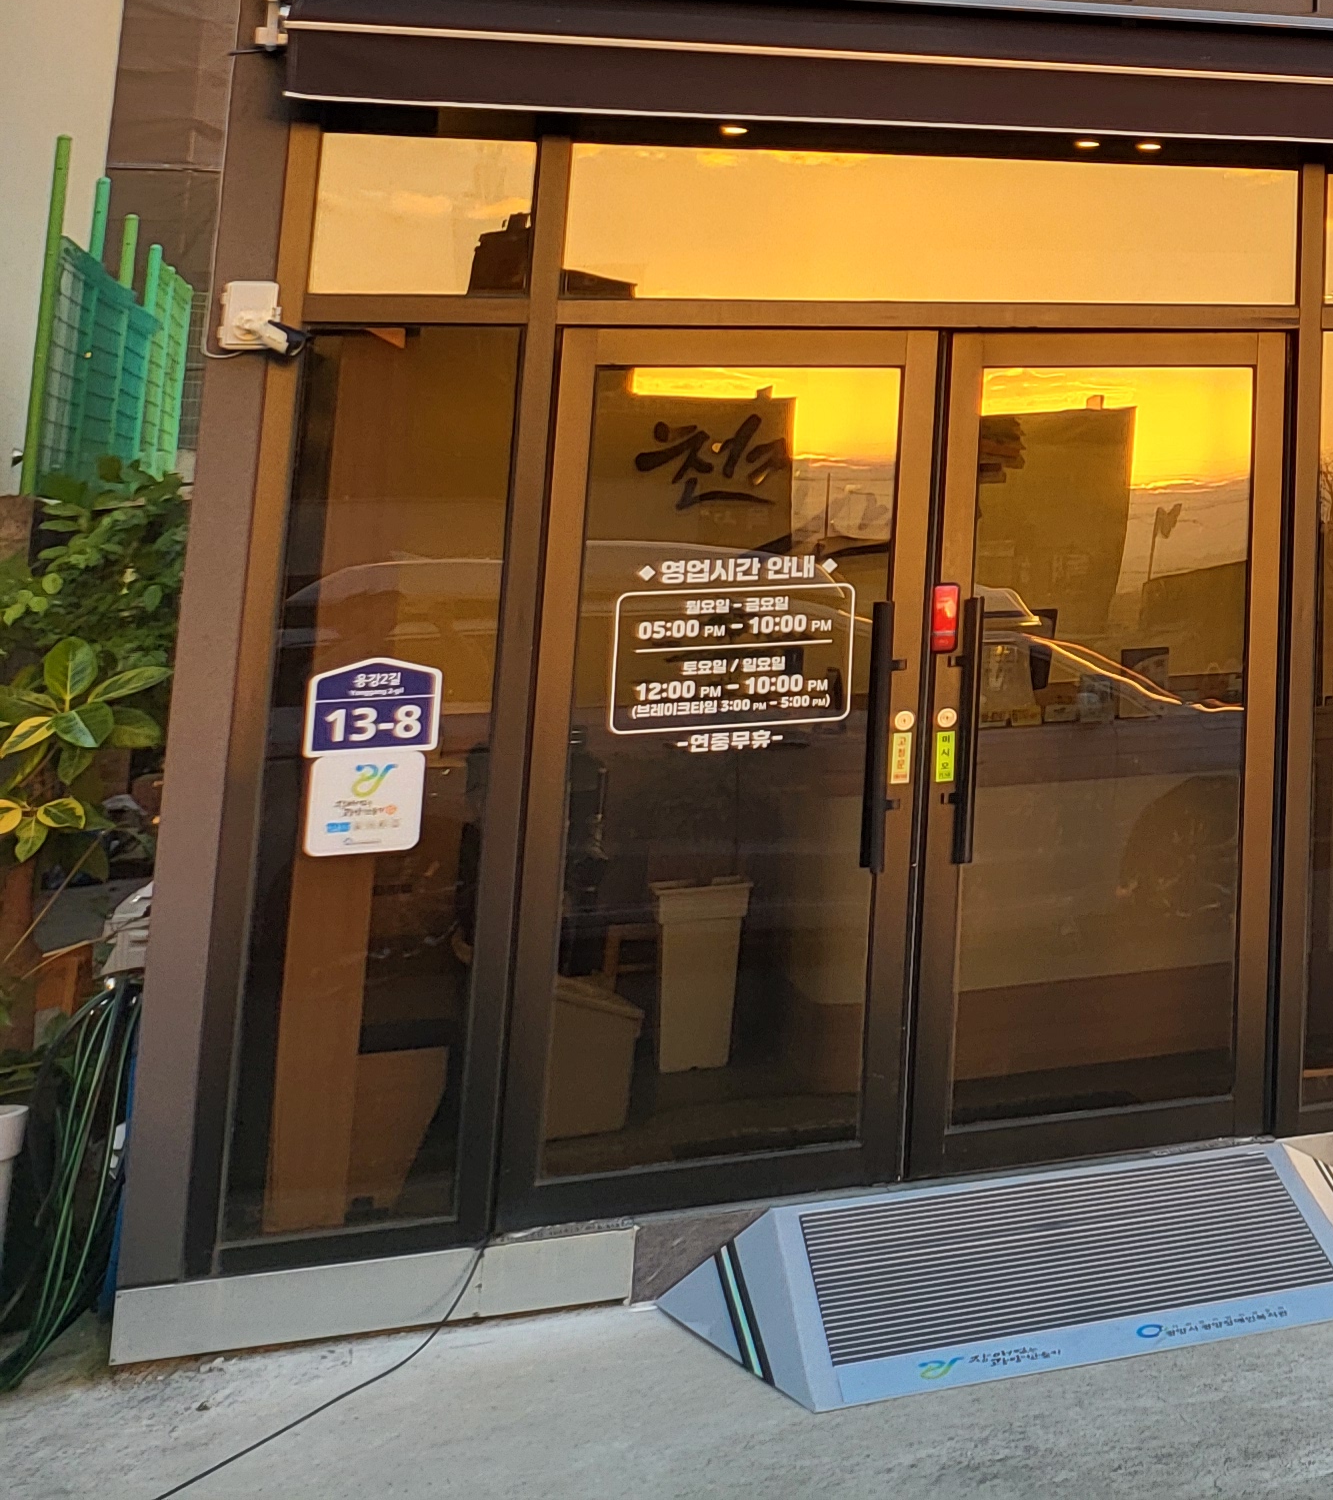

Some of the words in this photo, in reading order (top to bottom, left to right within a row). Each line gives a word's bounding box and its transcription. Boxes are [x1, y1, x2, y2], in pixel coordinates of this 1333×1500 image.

[660, 557, 761, 584] 영업시간
[766, 555, 815, 580] 안내
[685, 598, 730, 615] 월요일
[745, 596, 789, 613] 금요일
[638, 619, 700, 640] 05:00
[704, 624, 726, 637] PM
[749, 614, 807, 635] 10:00
[811, 619, 832, 632] PM
[682, 659, 727, 675] 토요일
[742, 656, 786, 672] 일요일
[352, 671, 402, 688] 용강2길
[635, 680, 696, 701] 12:00
[700, 685, 722, 698] PM
[745, 674, 804, 695] 10:00
[807, 679, 829, 692] PM
[631, 700, 718, 719] (브레이크타임
[720, 699, 751, 712] 3:00
[752, 702, 767, 711] PM
[780, 695, 810, 708] 5:00
[324, 705, 422, 743] 13-8
[940, 734, 951, 770] 미시오
